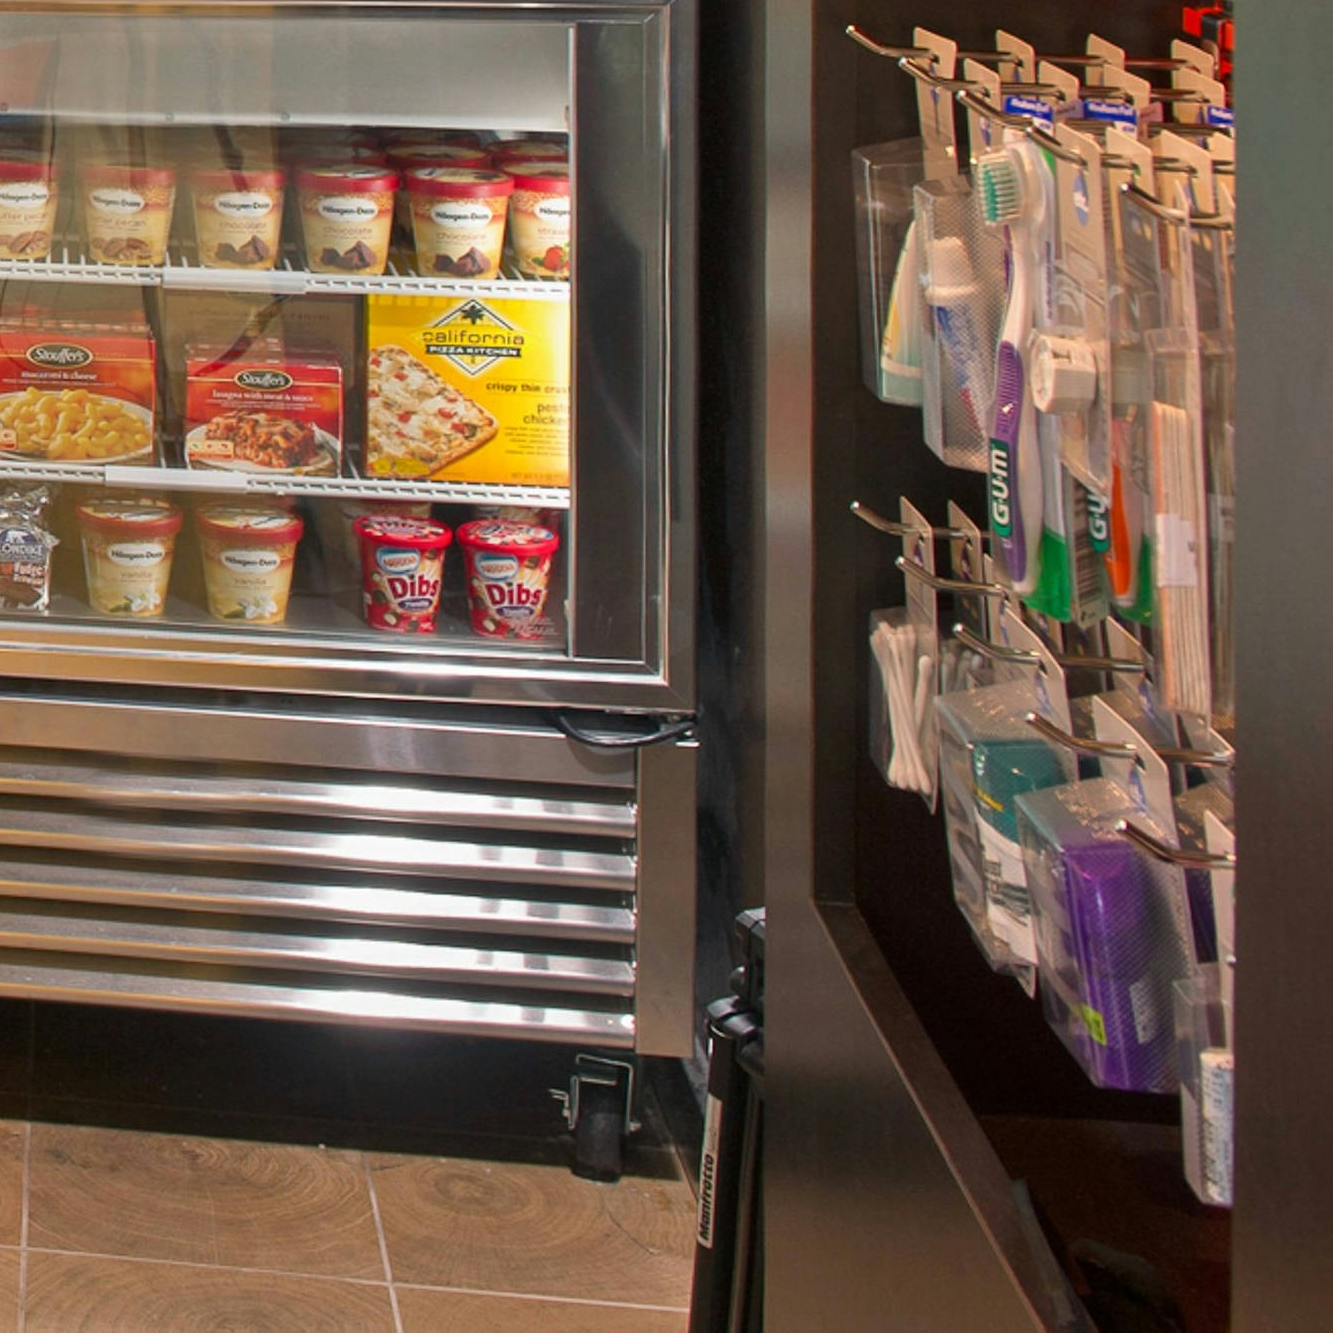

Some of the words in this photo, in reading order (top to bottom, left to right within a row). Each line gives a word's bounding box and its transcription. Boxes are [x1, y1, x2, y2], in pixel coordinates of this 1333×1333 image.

[422, 329, 525, 346] california
[429, 346, 464, 354] PIZZA
[467, 347, 518, 356] KITCHEN
[486, 382, 517, 393] crispy
[521, 383, 541, 392] thin
[386, 574, 439, 599] Dibs
[484, 581, 543, 607] Dibs
